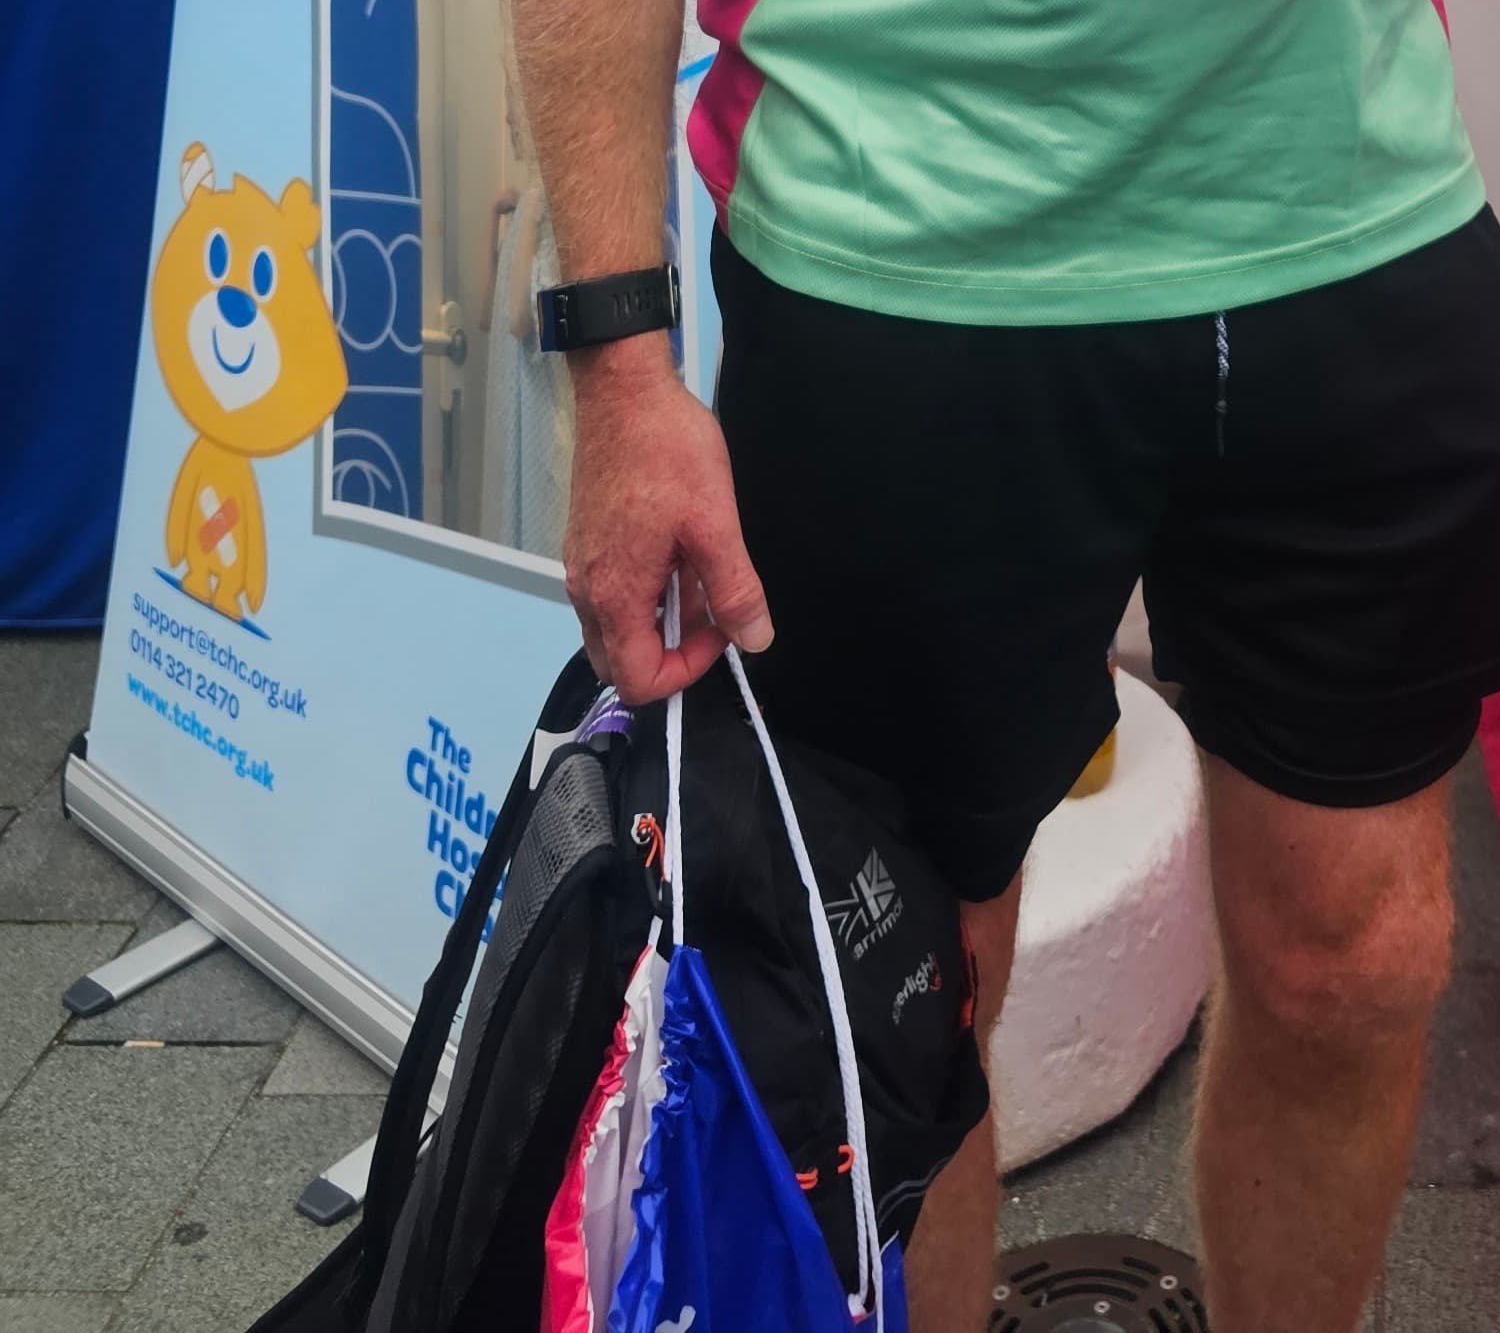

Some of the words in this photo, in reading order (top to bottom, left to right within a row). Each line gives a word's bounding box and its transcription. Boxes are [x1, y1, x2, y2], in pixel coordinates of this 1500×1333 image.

[130, 628, 162, 671] 0114
[165, 653, 193, 691] 321
[195, 672, 240, 720] 2470
[132, 592, 308, 719] support@tchc.org.uk
[127, 671, 275, 792] www.tchc.org.uk
[428, 715, 472, 774] The
[406, 746, 499, 841] Childr
